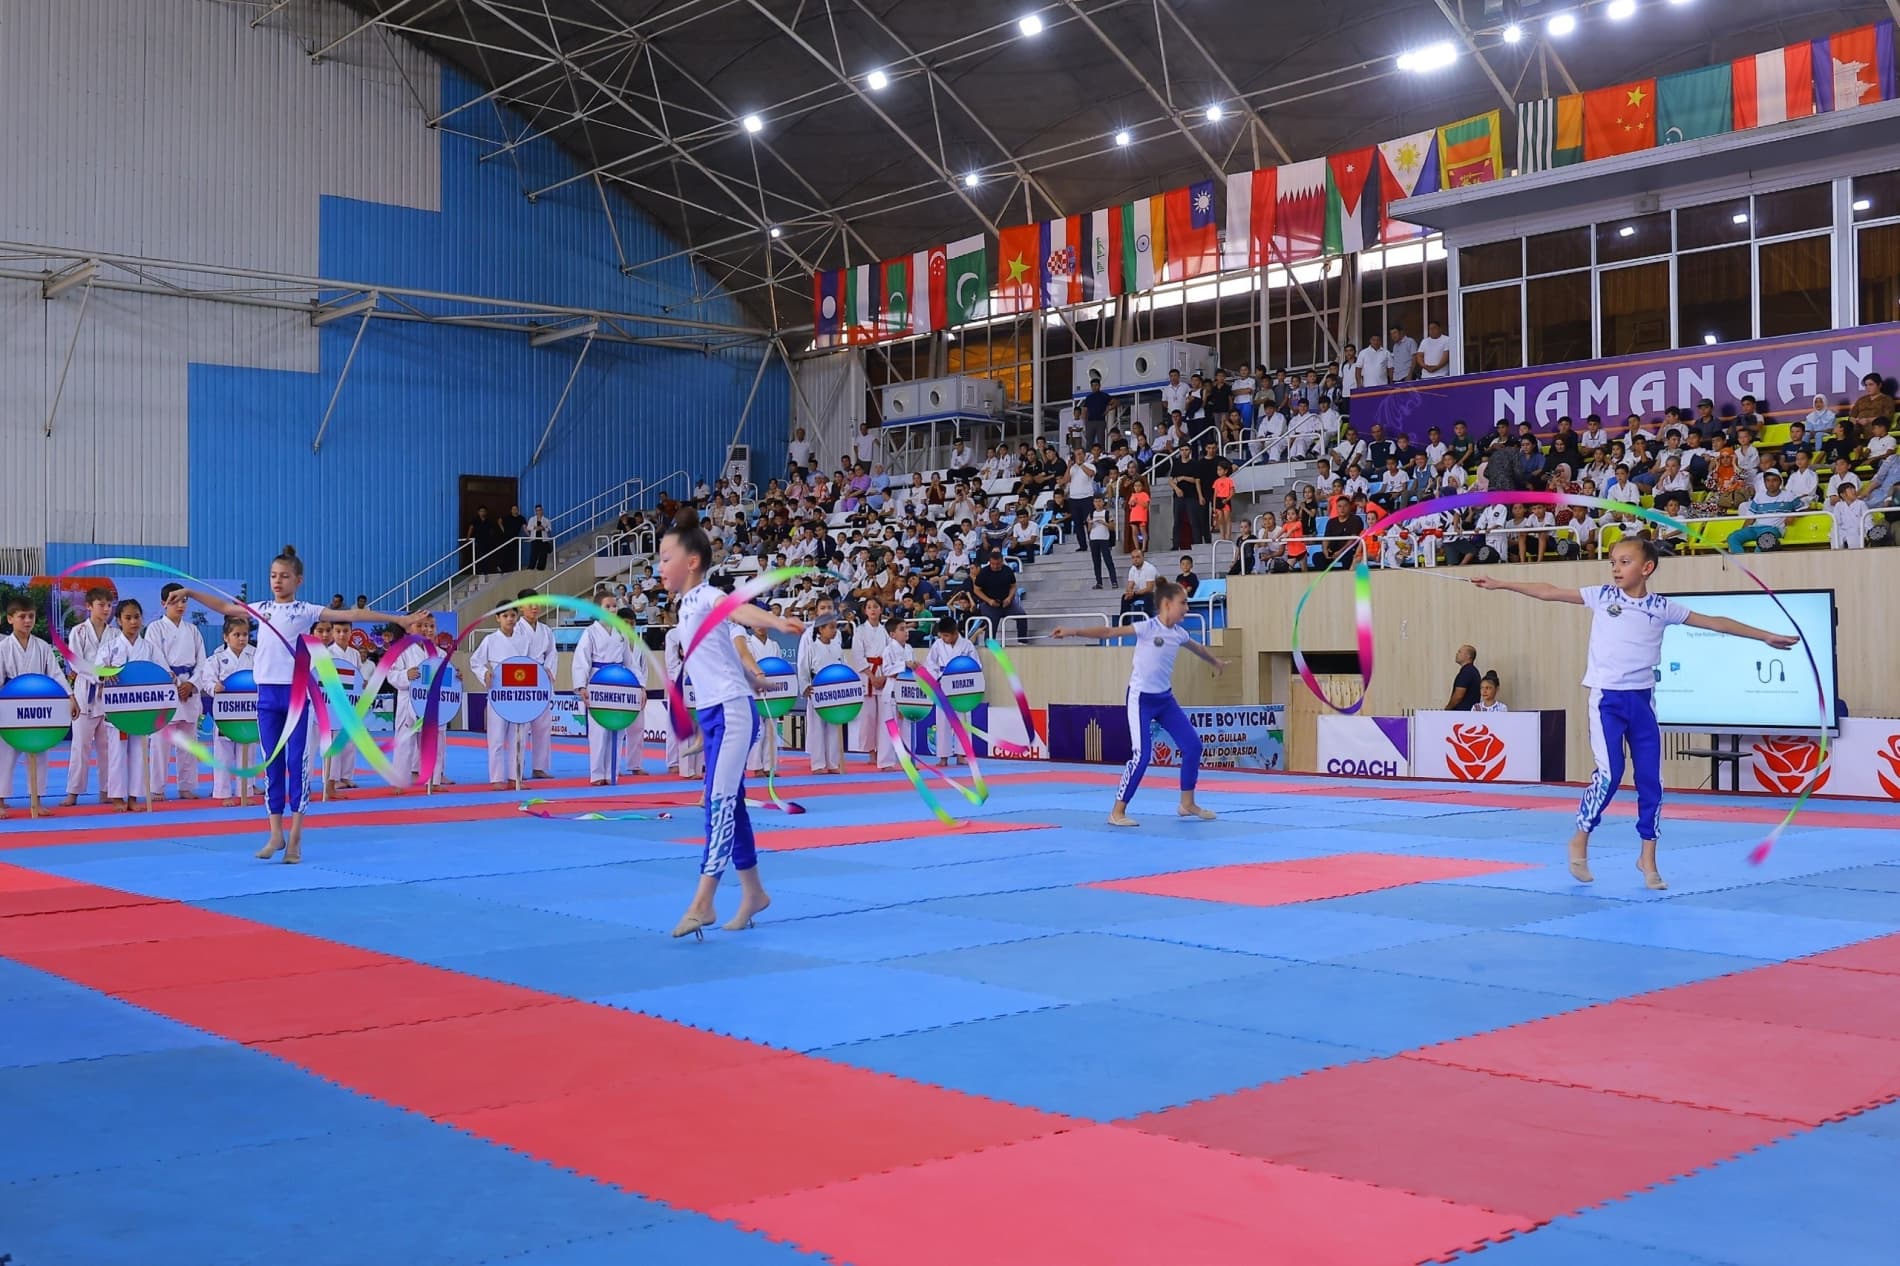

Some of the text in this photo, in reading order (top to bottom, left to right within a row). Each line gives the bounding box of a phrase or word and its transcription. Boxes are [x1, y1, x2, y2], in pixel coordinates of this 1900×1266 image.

[1493, 345, 1874, 428] NAMANGAN
[952, 678, 975, 690] XORAZM
[104, 690, 175, 705] NAMANGAN-2
[491, 690, 549, 703] QIRG'IZISTON
[590, 690, 626, 704] TOSHKENT
[814, 687, 862, 703] QASHQADARYO
[17, 706, 52, 719] NAVOIY
[217, 700, 257, 713] TOSHKEN
[1216, 711, 1276, 727] BO'YICHA
[643, 729, 667, 741] COAC
[1218, 733, 1247, 743] GULLAR
[1218, 746, 1257, 757] DO'RASIDA
[1327, 758, 1397, 776] COACH
